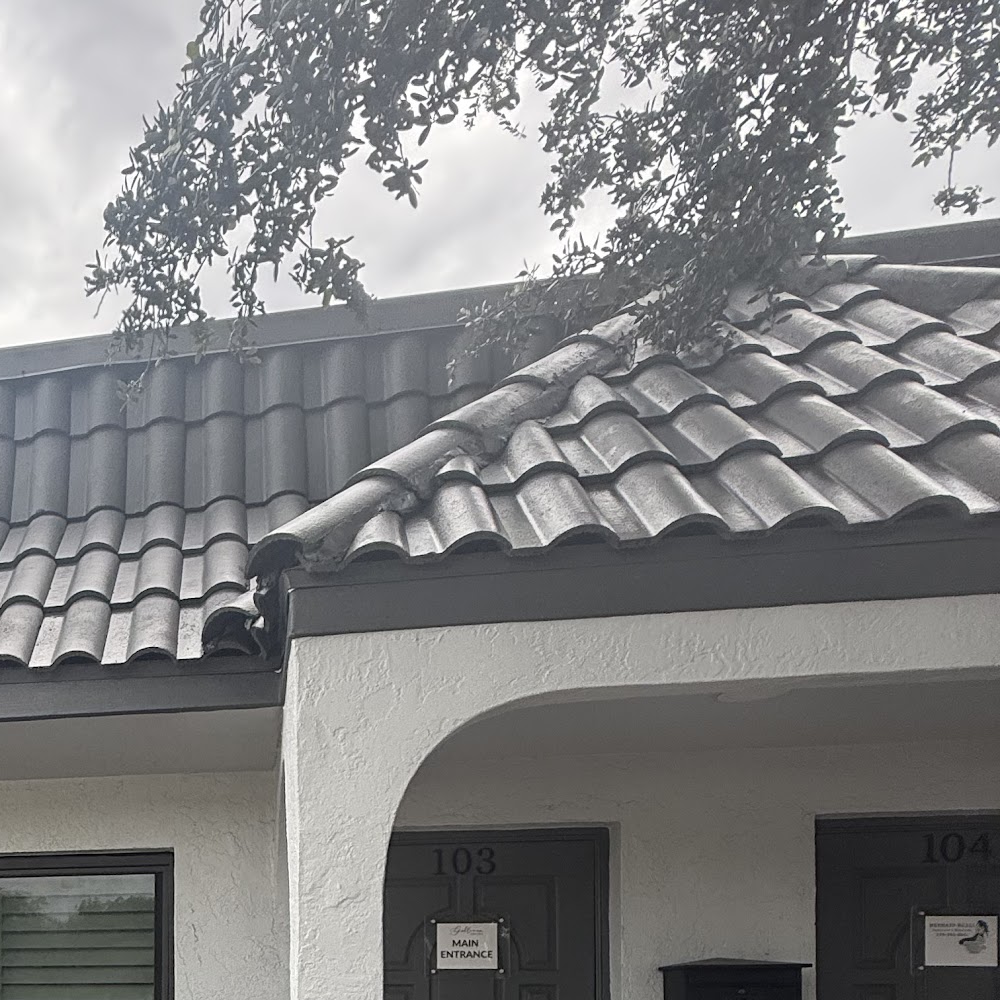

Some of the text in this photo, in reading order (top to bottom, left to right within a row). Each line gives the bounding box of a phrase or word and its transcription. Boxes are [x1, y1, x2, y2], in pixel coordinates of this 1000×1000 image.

[921, 832, 992, 864] 104
[432, 847, 496, 876] 103
[452, 939, 479, 947] MAIN
[440, 950, 493, 959] ENTRANCE
